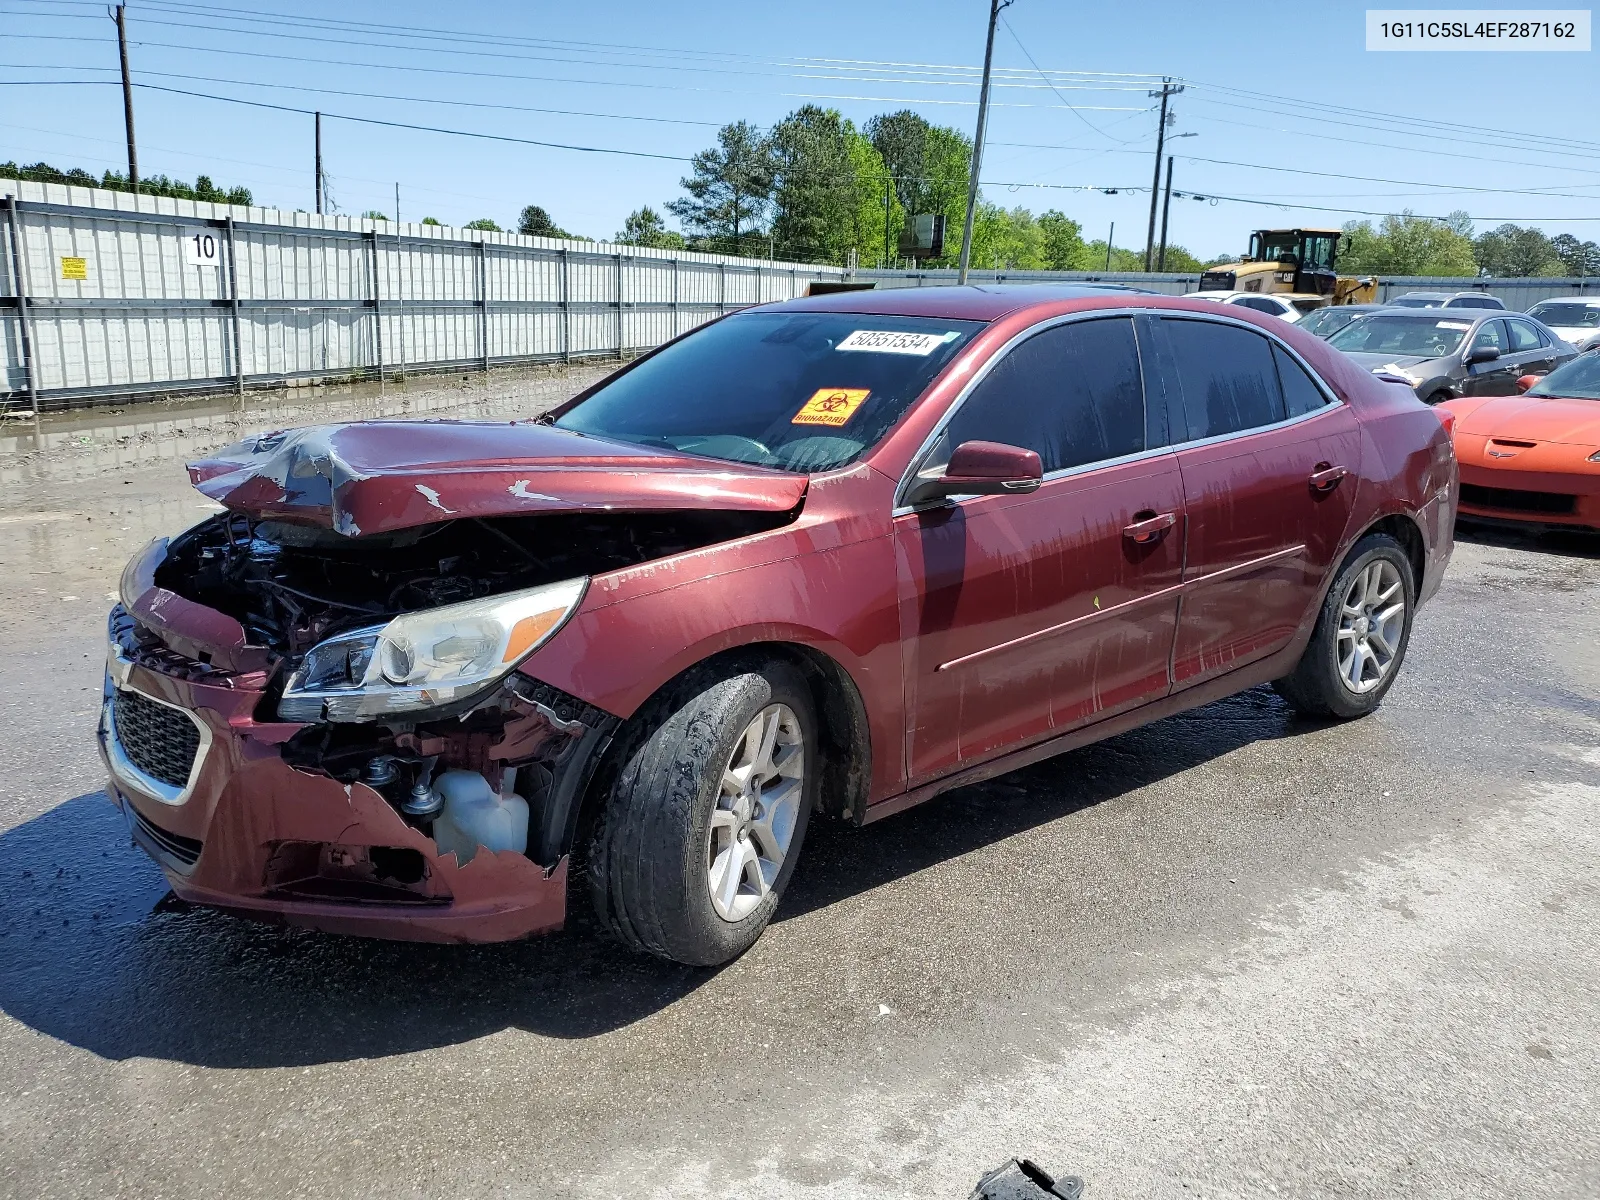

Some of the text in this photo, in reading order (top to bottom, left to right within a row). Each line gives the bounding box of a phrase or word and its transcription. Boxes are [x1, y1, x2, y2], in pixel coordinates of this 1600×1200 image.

[192, 233, 215, 259] 10
[1283, 272, 1295, 282] CAT
[795, 414, 847, 424] BIOHAZARD
